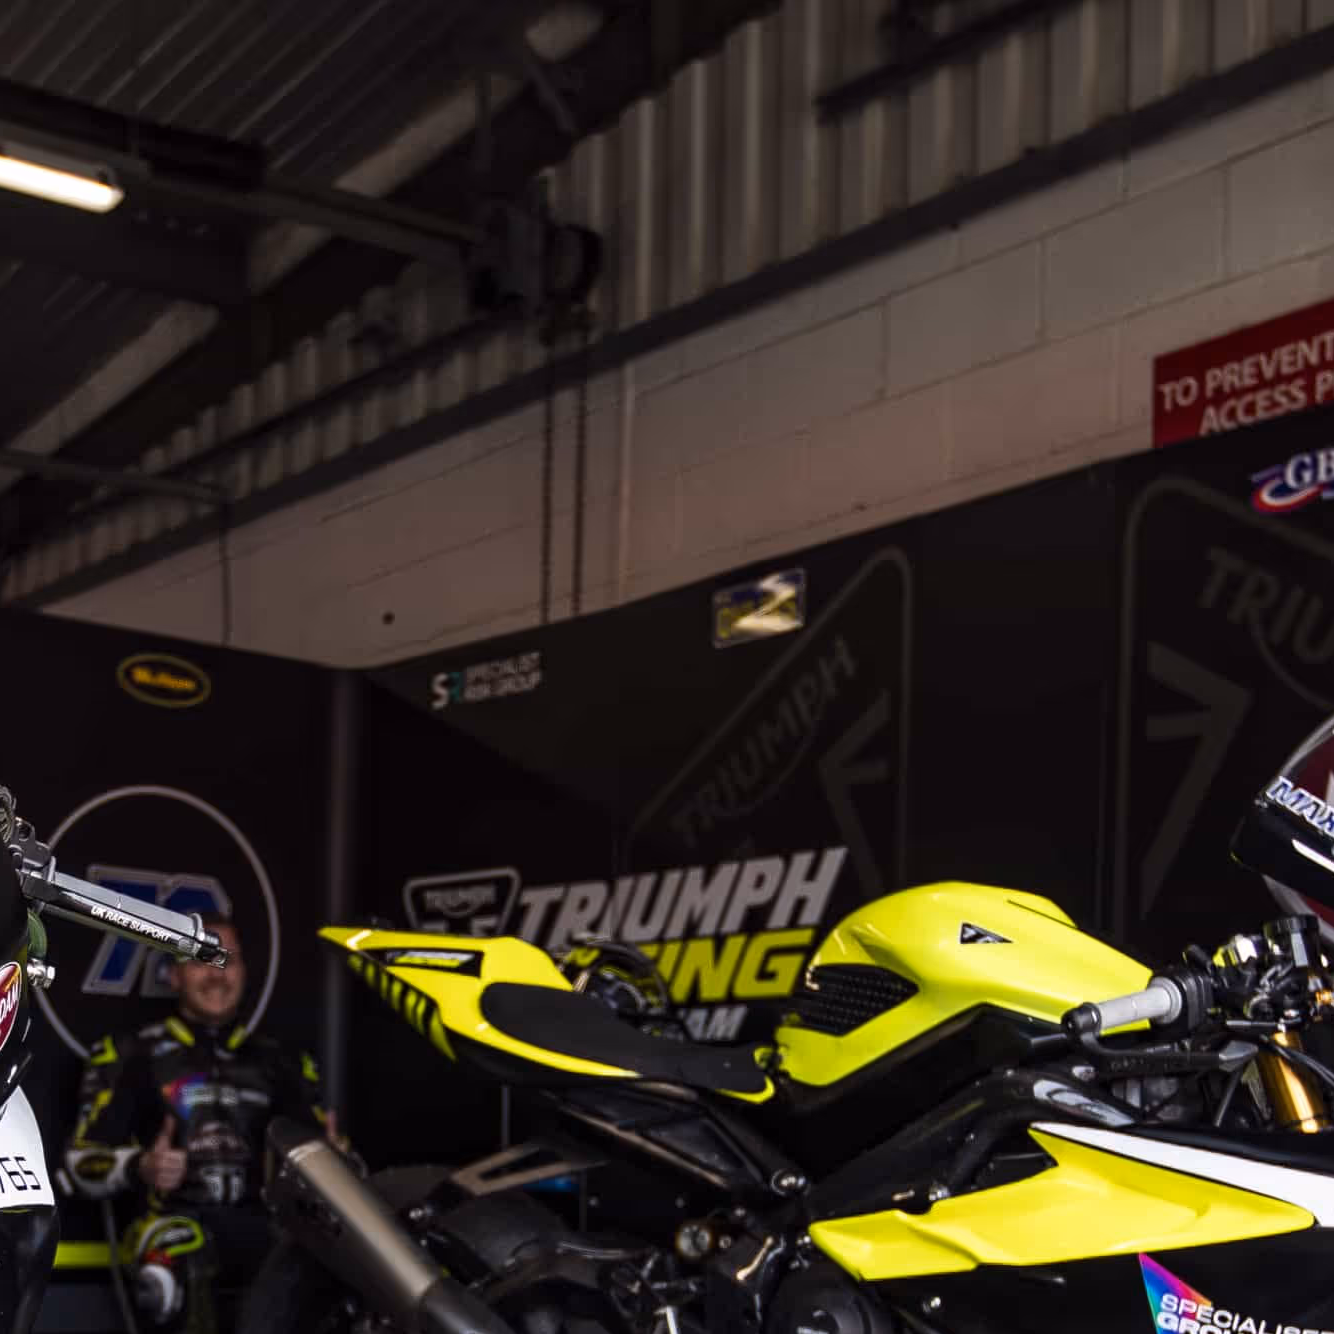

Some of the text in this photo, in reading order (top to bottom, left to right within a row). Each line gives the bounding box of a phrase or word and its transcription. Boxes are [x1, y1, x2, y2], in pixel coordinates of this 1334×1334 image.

[1157, 378, 1198, 414] TO
[1198, 376, 1308, 438] ACCESS
[91, 905, 172, 942] UK RACE SUPPORT
[518, 846, 849, 955] TRIUMPH
